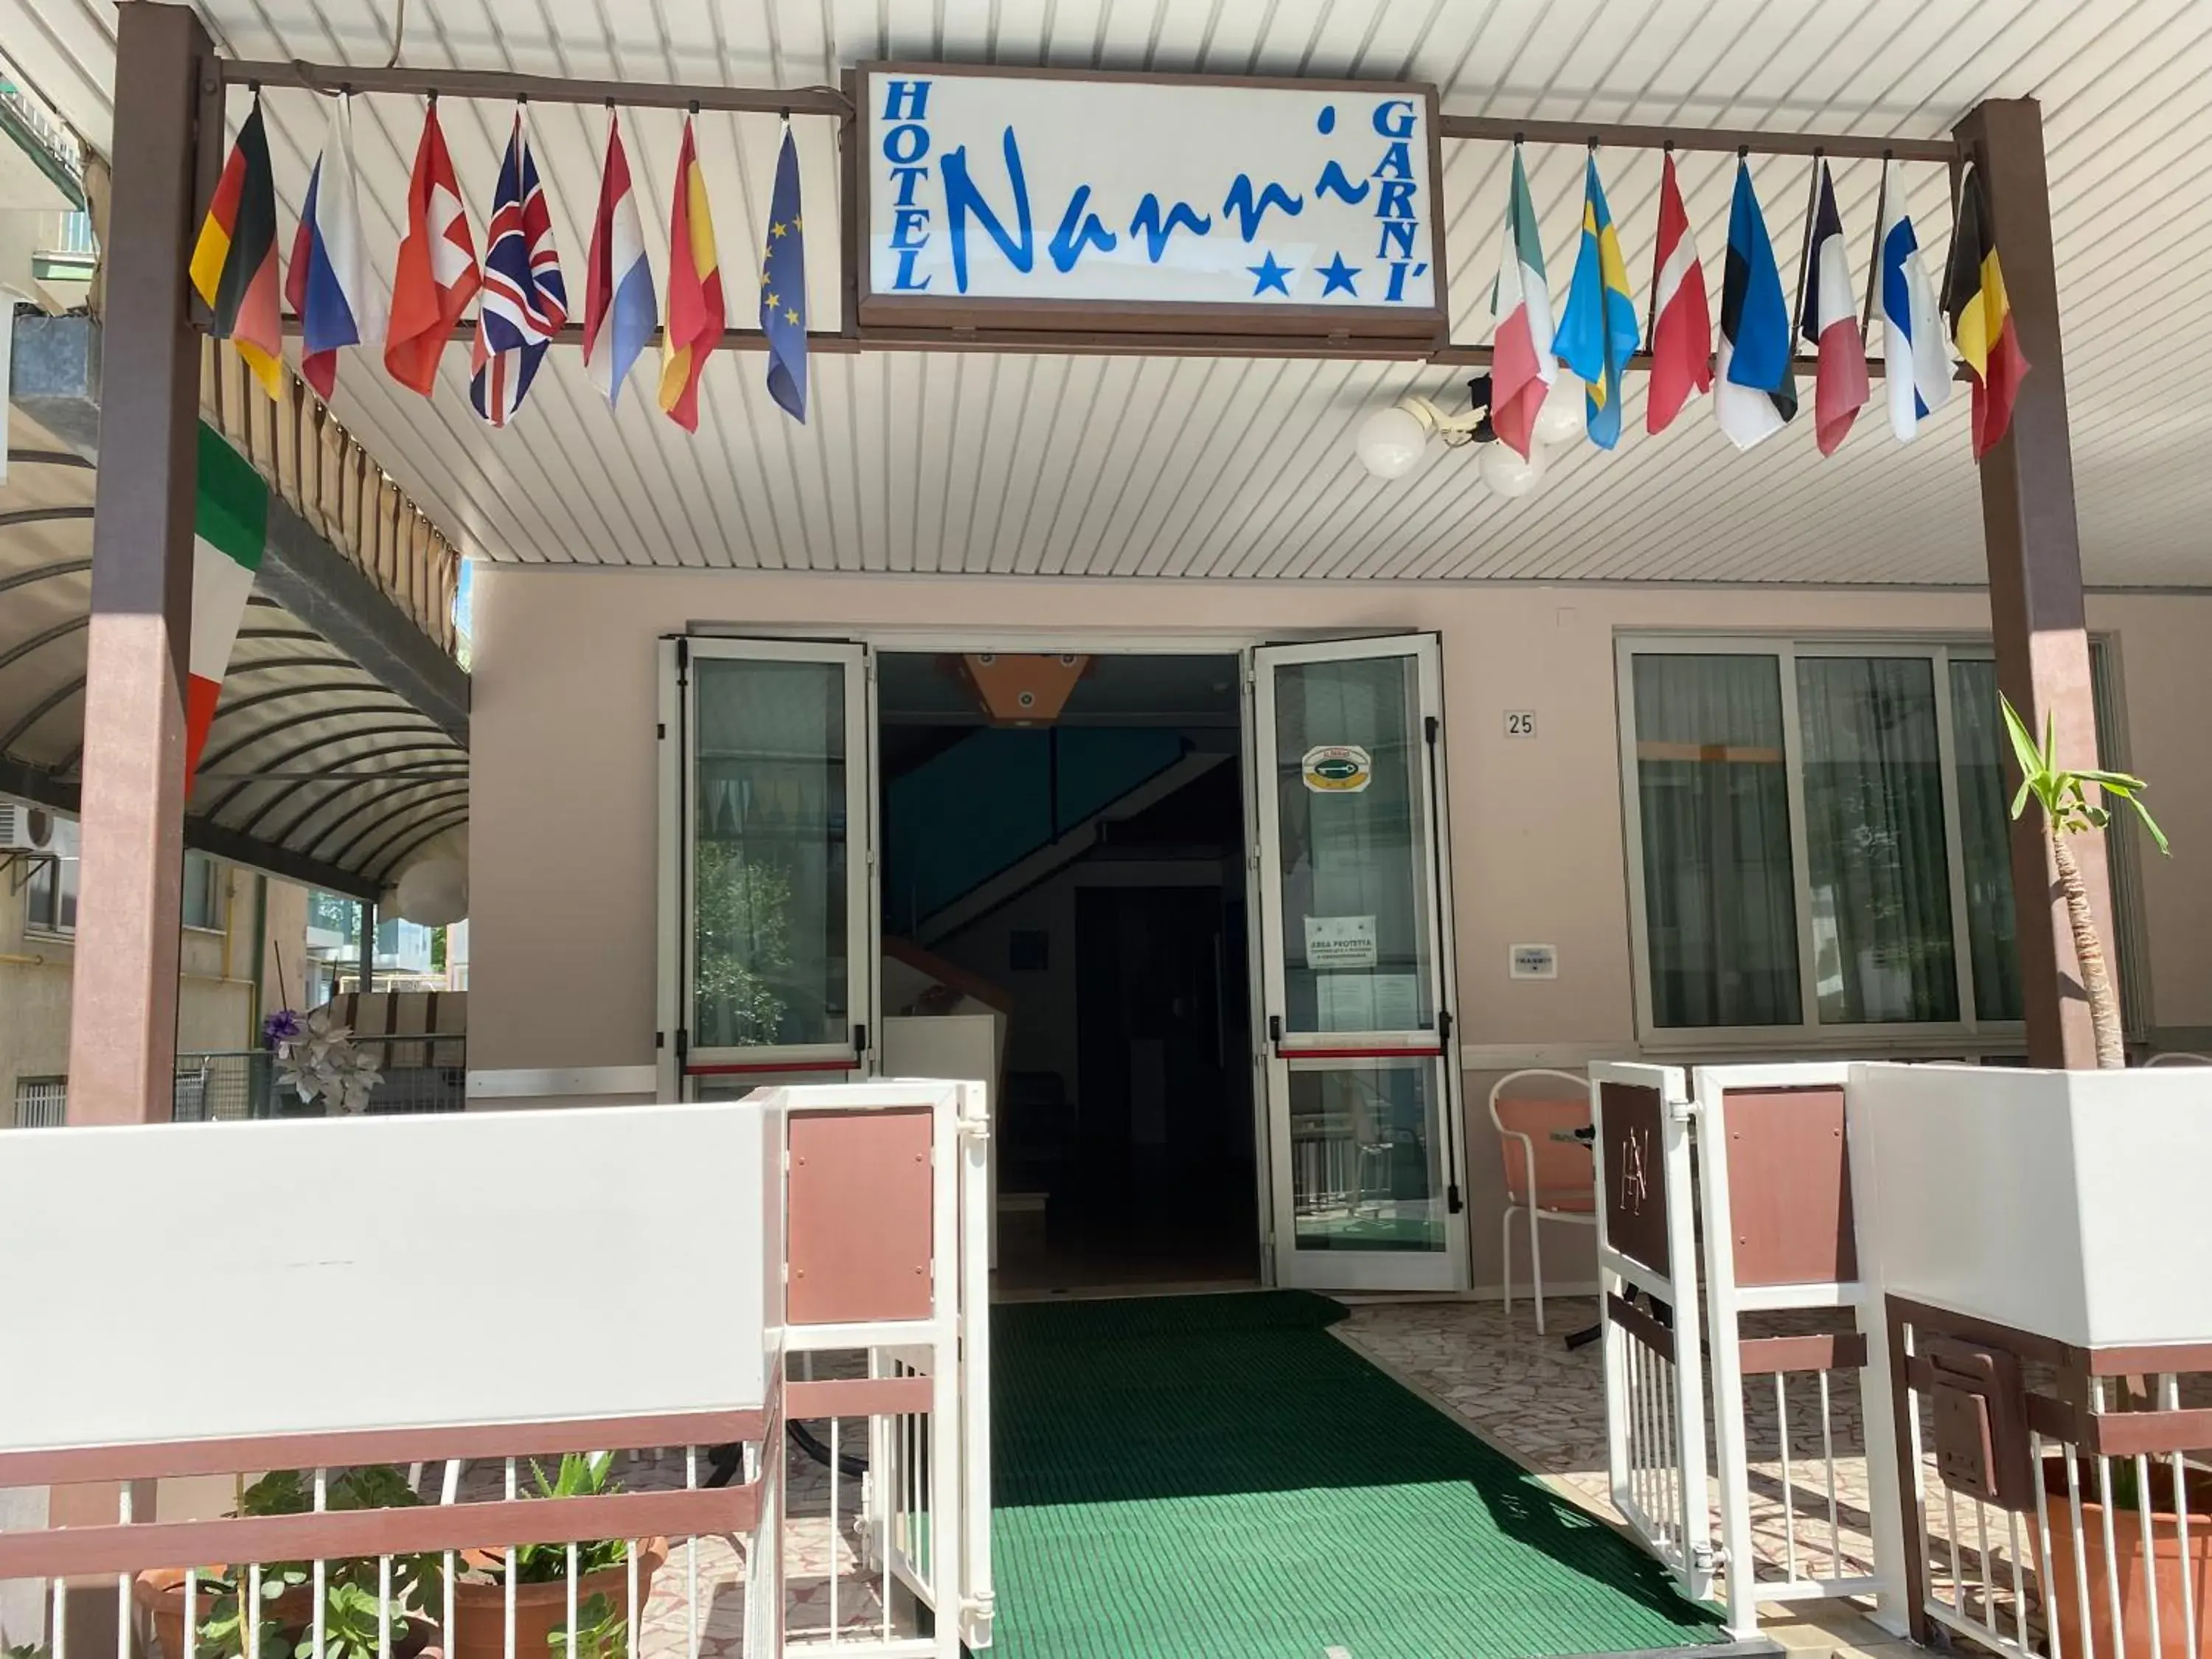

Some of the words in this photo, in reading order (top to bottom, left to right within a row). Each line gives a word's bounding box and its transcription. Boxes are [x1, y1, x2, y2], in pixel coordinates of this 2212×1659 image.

[882, 80, 931, 291] HOTEL
[939, 105, 1370, 295] Nanni
[1509, 714, 1532, 734] 25
[1333, 939, 1372, 947] PROTETTA
